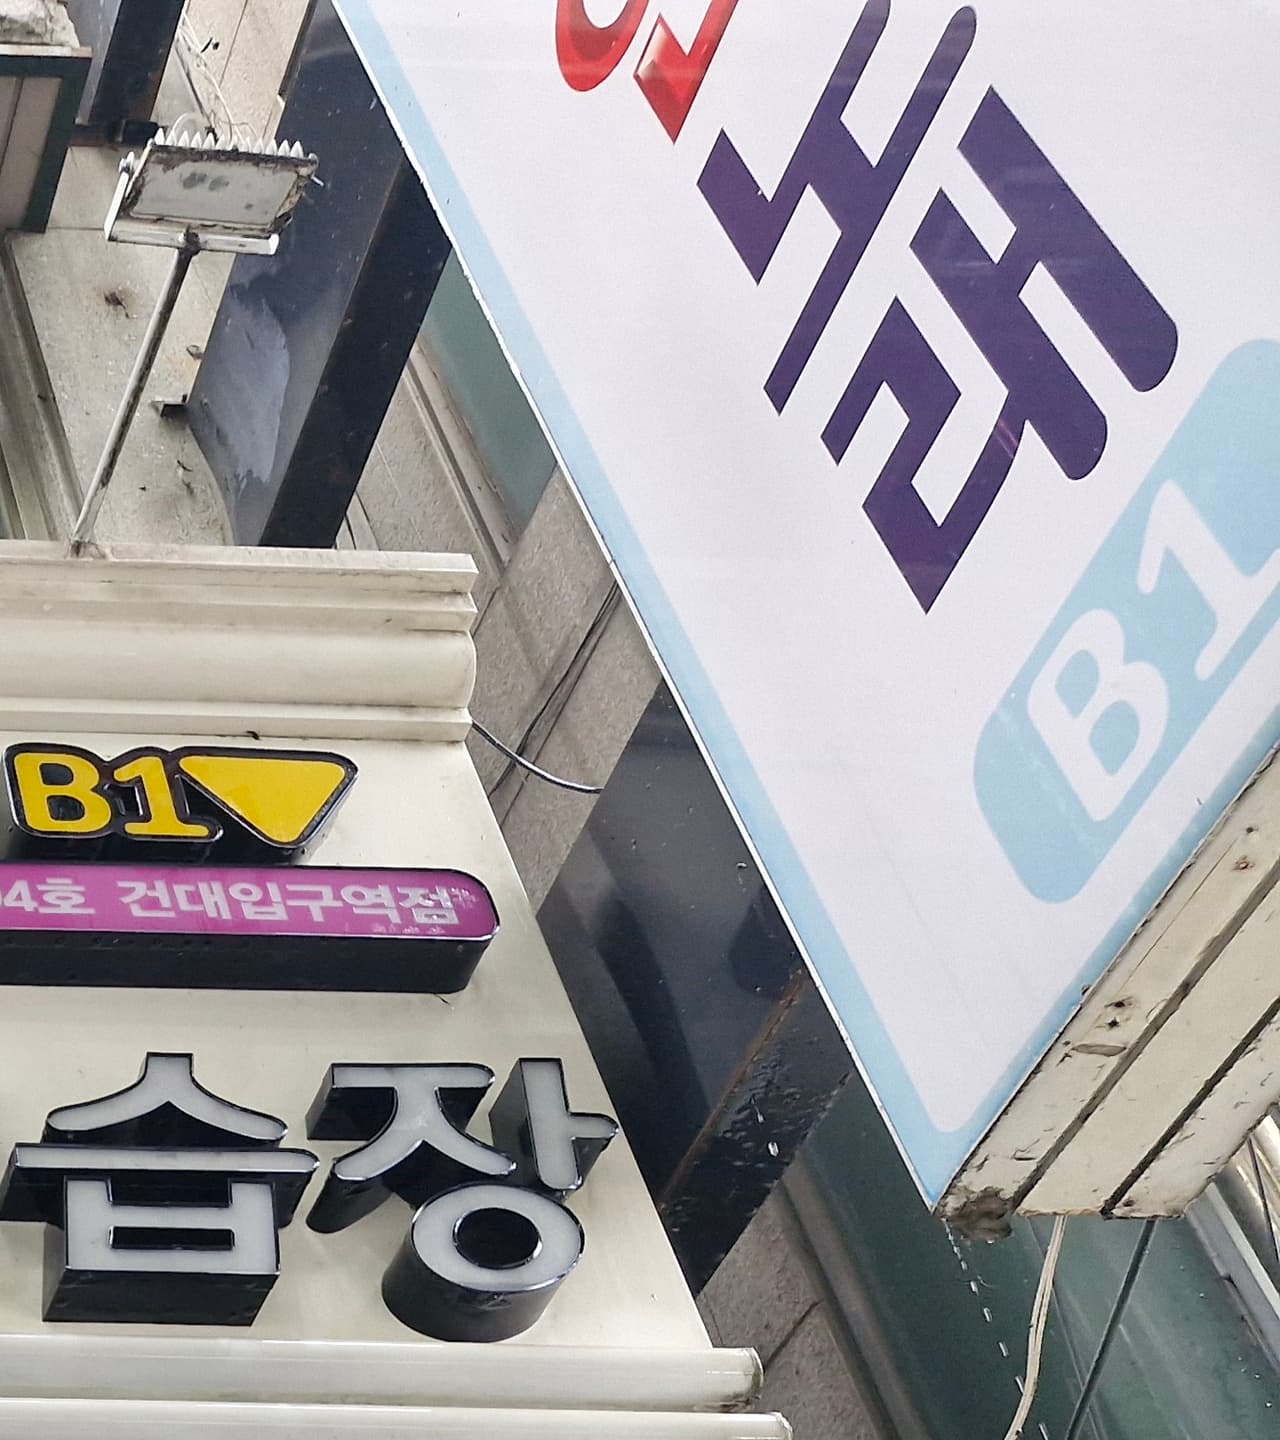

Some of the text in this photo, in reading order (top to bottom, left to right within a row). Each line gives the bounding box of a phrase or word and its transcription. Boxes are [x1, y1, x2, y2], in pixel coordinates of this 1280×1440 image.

[1027, 478, 1280, 822] B1
[8, 750, 213, 842] B1
[118, 880, 462, 927] 건대입구역점
